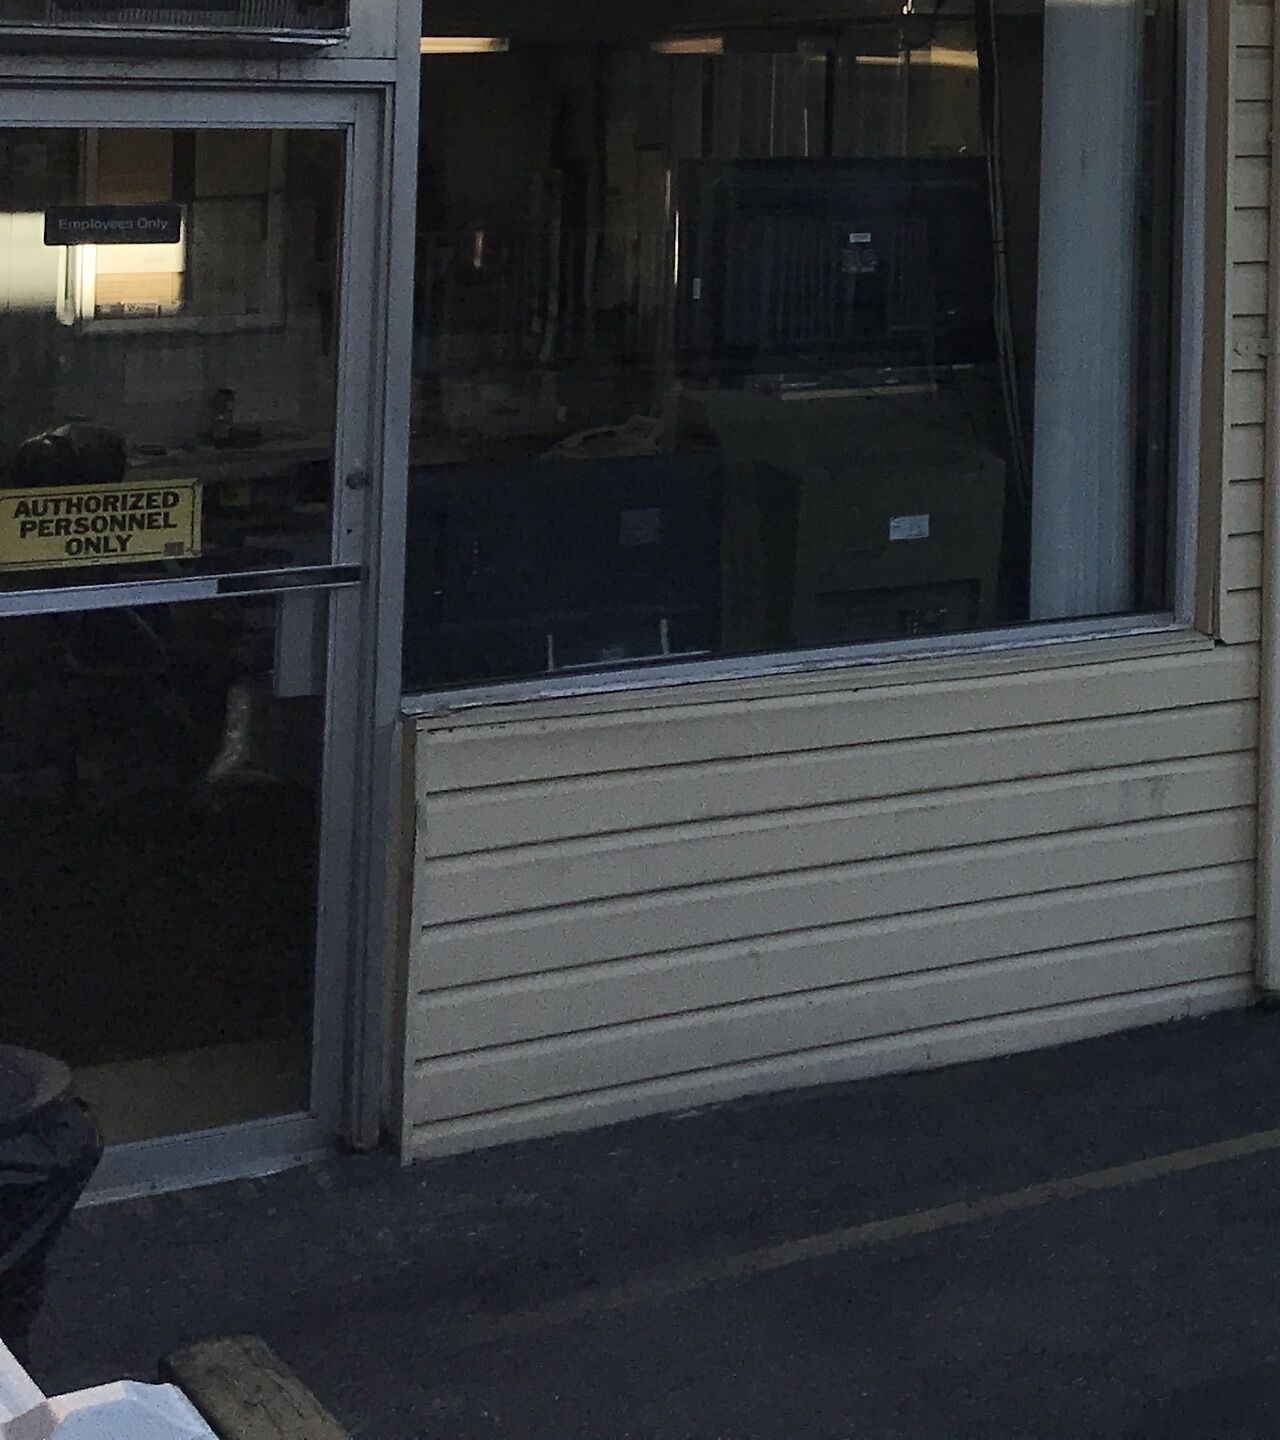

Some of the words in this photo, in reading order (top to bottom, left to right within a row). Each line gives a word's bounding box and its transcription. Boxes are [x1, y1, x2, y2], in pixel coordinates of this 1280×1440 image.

[58, 217, 134, 231] Employees
[137, 216, 169, 231] Only
[13, 489, 180, 518] AUTHORIZED
[19, 511, 178, 539] PERSONNEL
[64, 534, 134, 557] ONLY
